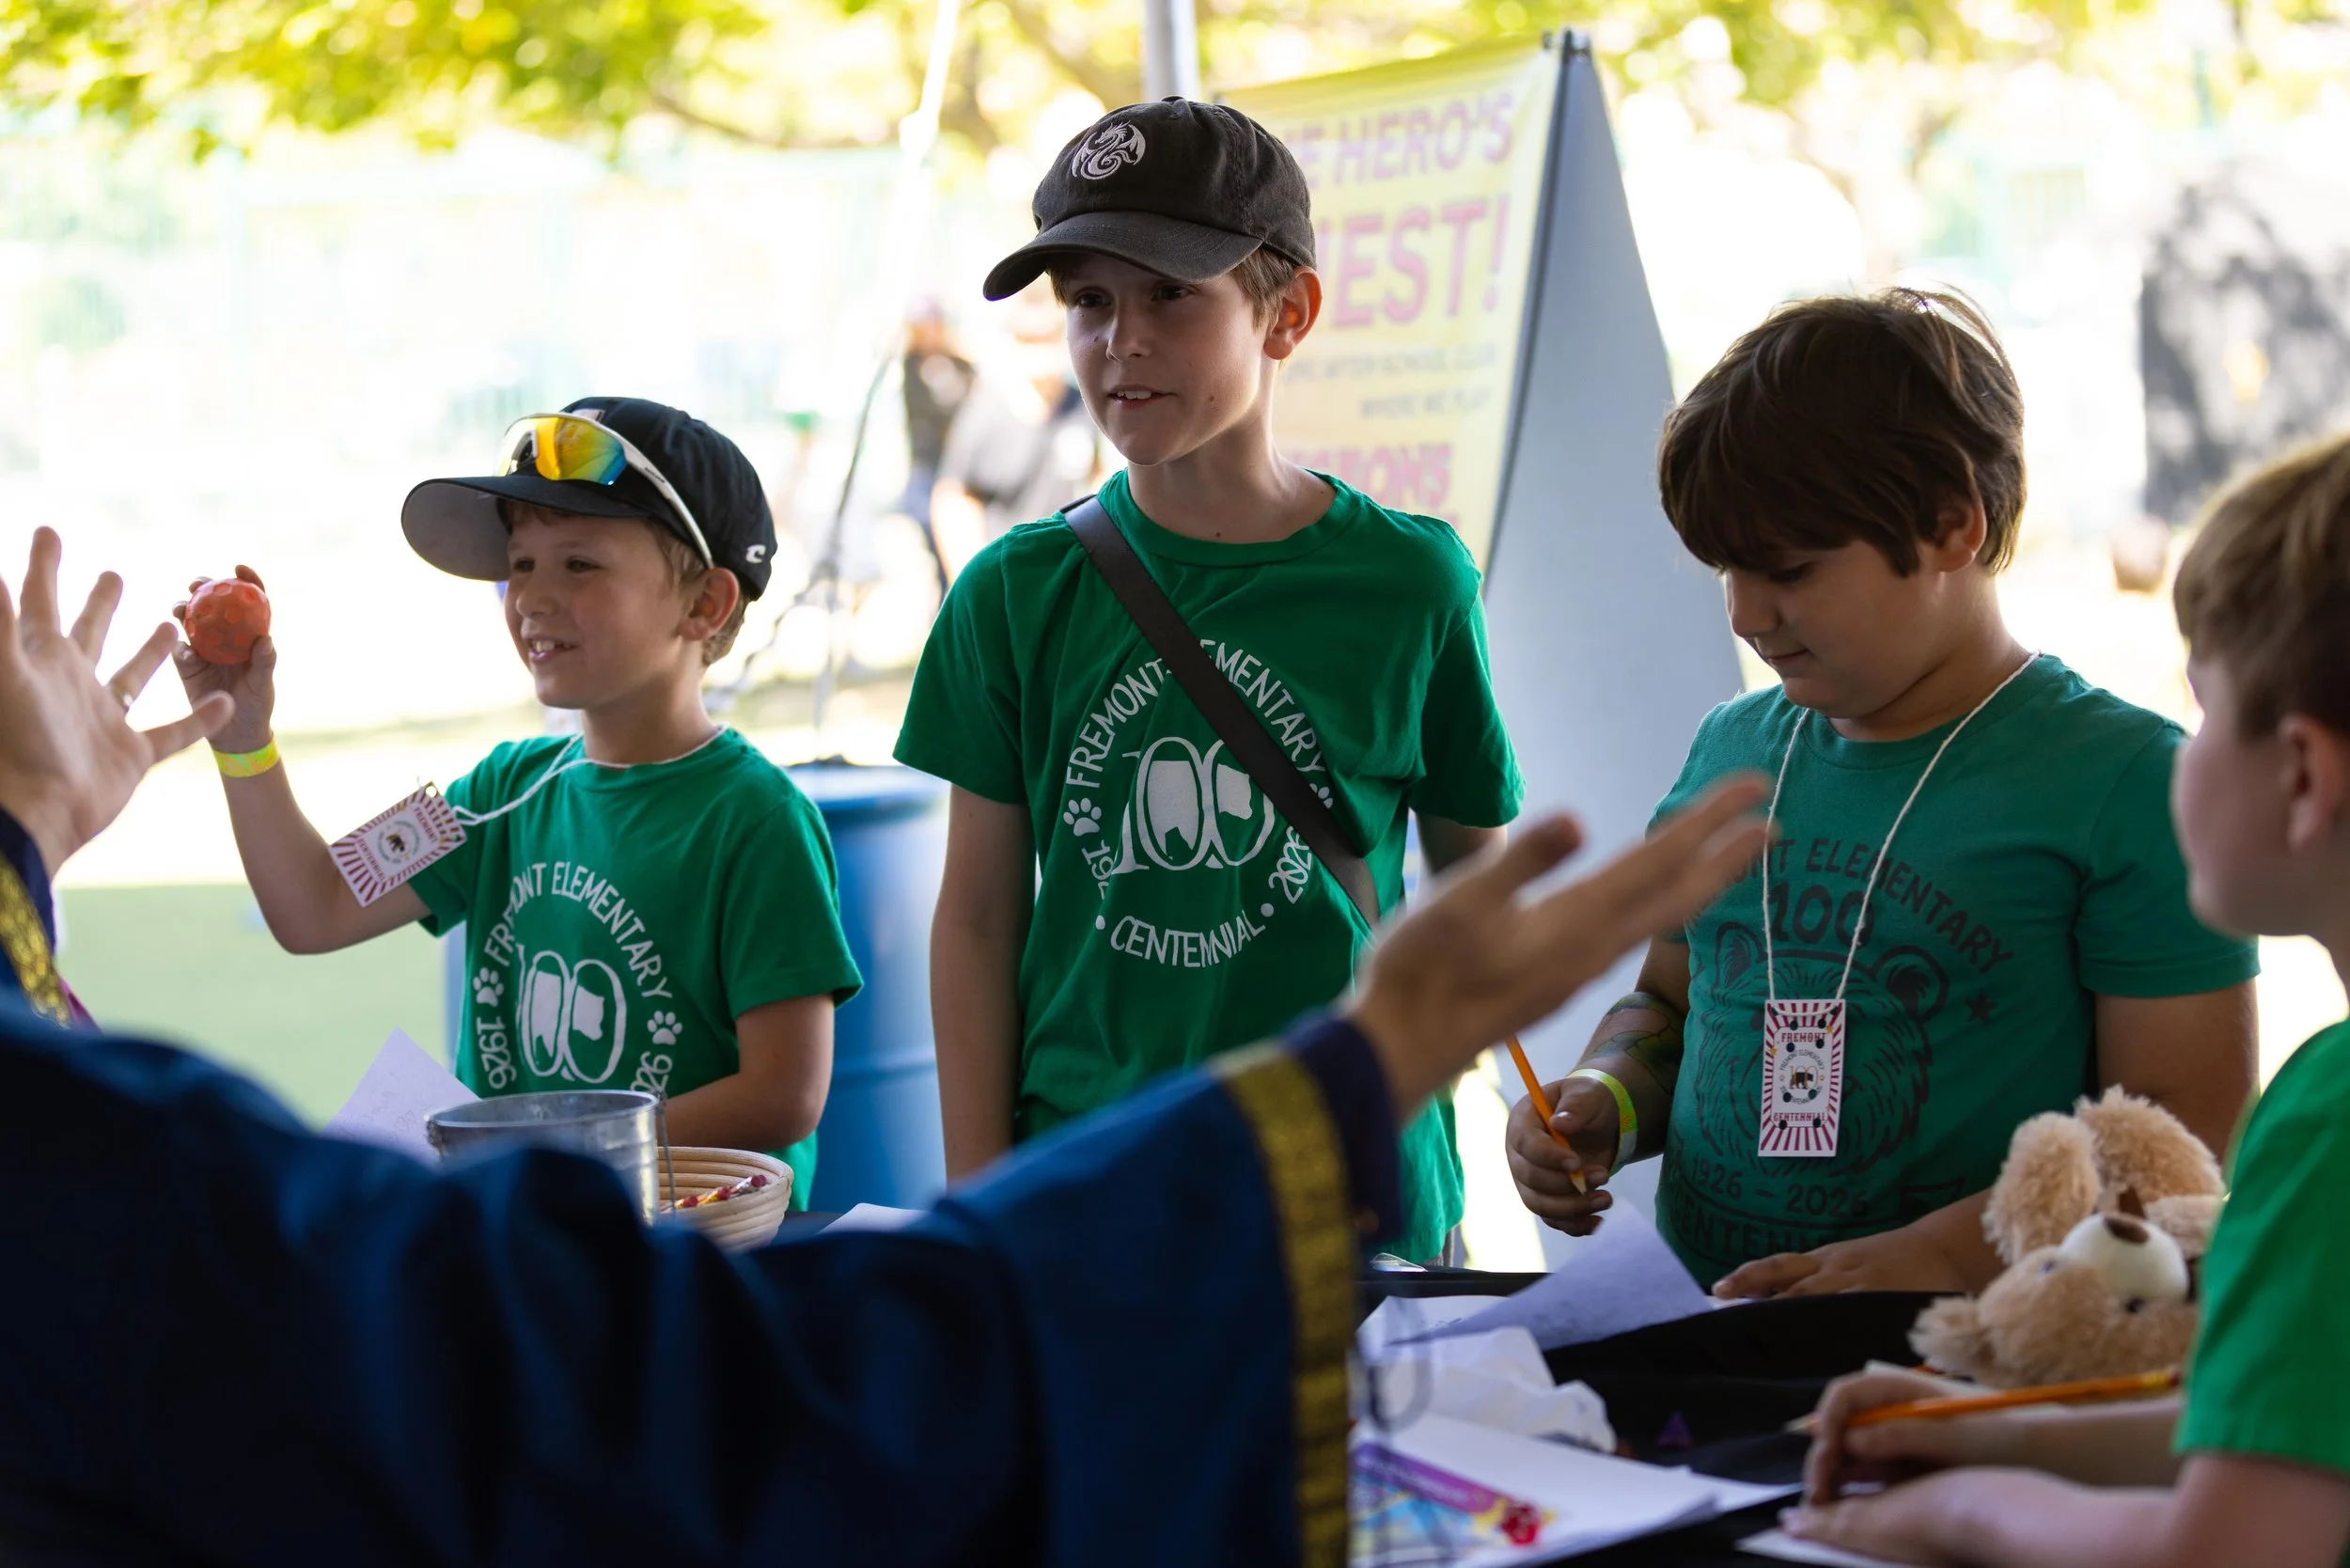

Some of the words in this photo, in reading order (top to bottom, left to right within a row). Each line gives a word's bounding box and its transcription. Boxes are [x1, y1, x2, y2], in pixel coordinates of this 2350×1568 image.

[1333, 91, 1513, 185] HERO'S
[1066, 658, 1163, 788] FREMONT
[551, 861, 673, 999] ELEMENTARY
[1110, 909, 1266, 967] CENTENNIAL
[1768, 881, 1875, 948] 100
[1805, 838, 2013, 974] ELEMENTARY
[476, 1016, 517, 1090] 1926
[1693, 1152, 1743, 1200] 1926
[1786, 1183, 1869, 1217] 2026
